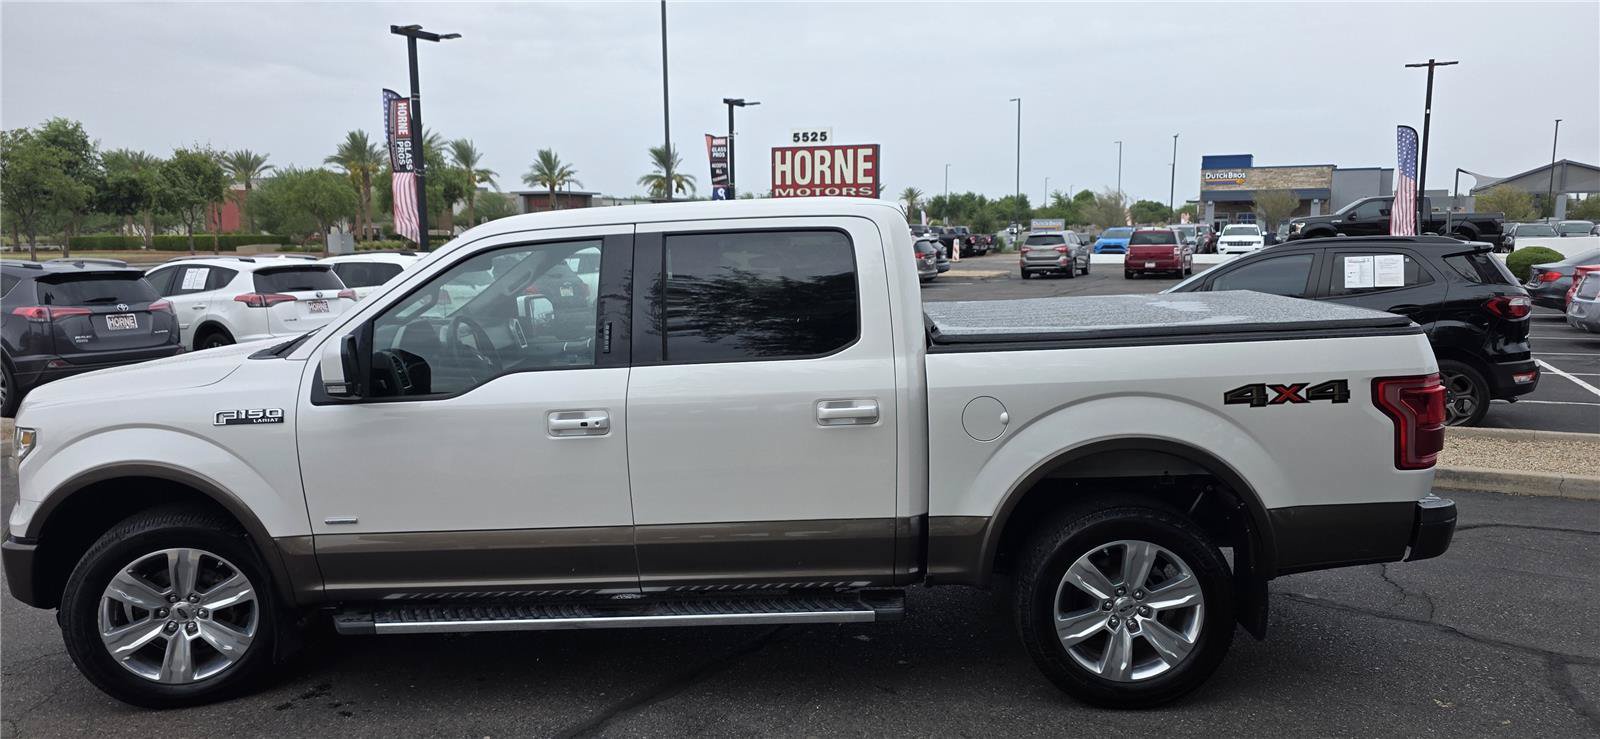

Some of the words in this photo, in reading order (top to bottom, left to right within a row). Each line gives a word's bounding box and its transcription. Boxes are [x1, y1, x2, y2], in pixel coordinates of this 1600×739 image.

[397, 102, 408, 135] HORNE
[792, 131, 828, 142] 5525
[397, 141, 405, 166] PROS
[404, 141, 413, 171] GLASS
[774, 148, 873, 186] HORNE
[774, 186, 873, 197] MOTORS
[108, 316, 135, 328] HORNE
